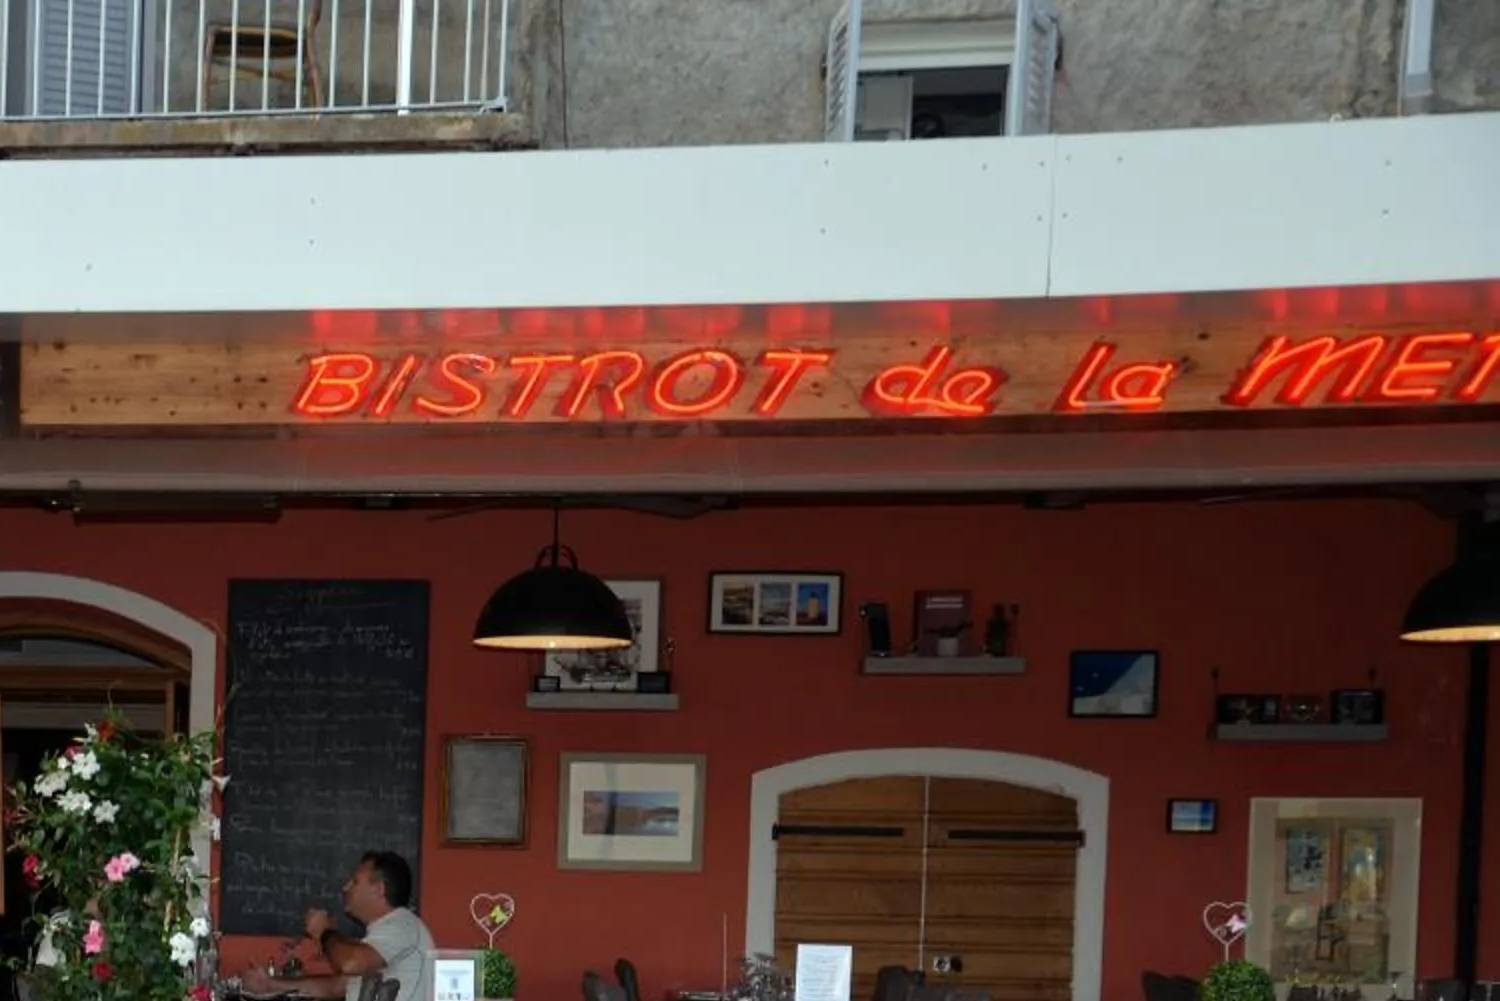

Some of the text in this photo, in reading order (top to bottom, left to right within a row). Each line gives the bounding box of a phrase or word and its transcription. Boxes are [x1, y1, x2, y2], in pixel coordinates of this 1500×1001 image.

[295, 347, 836, 418] BISTROT
[860, 342, 1008, 417] de
[1053, 340, 1192, 413] la
